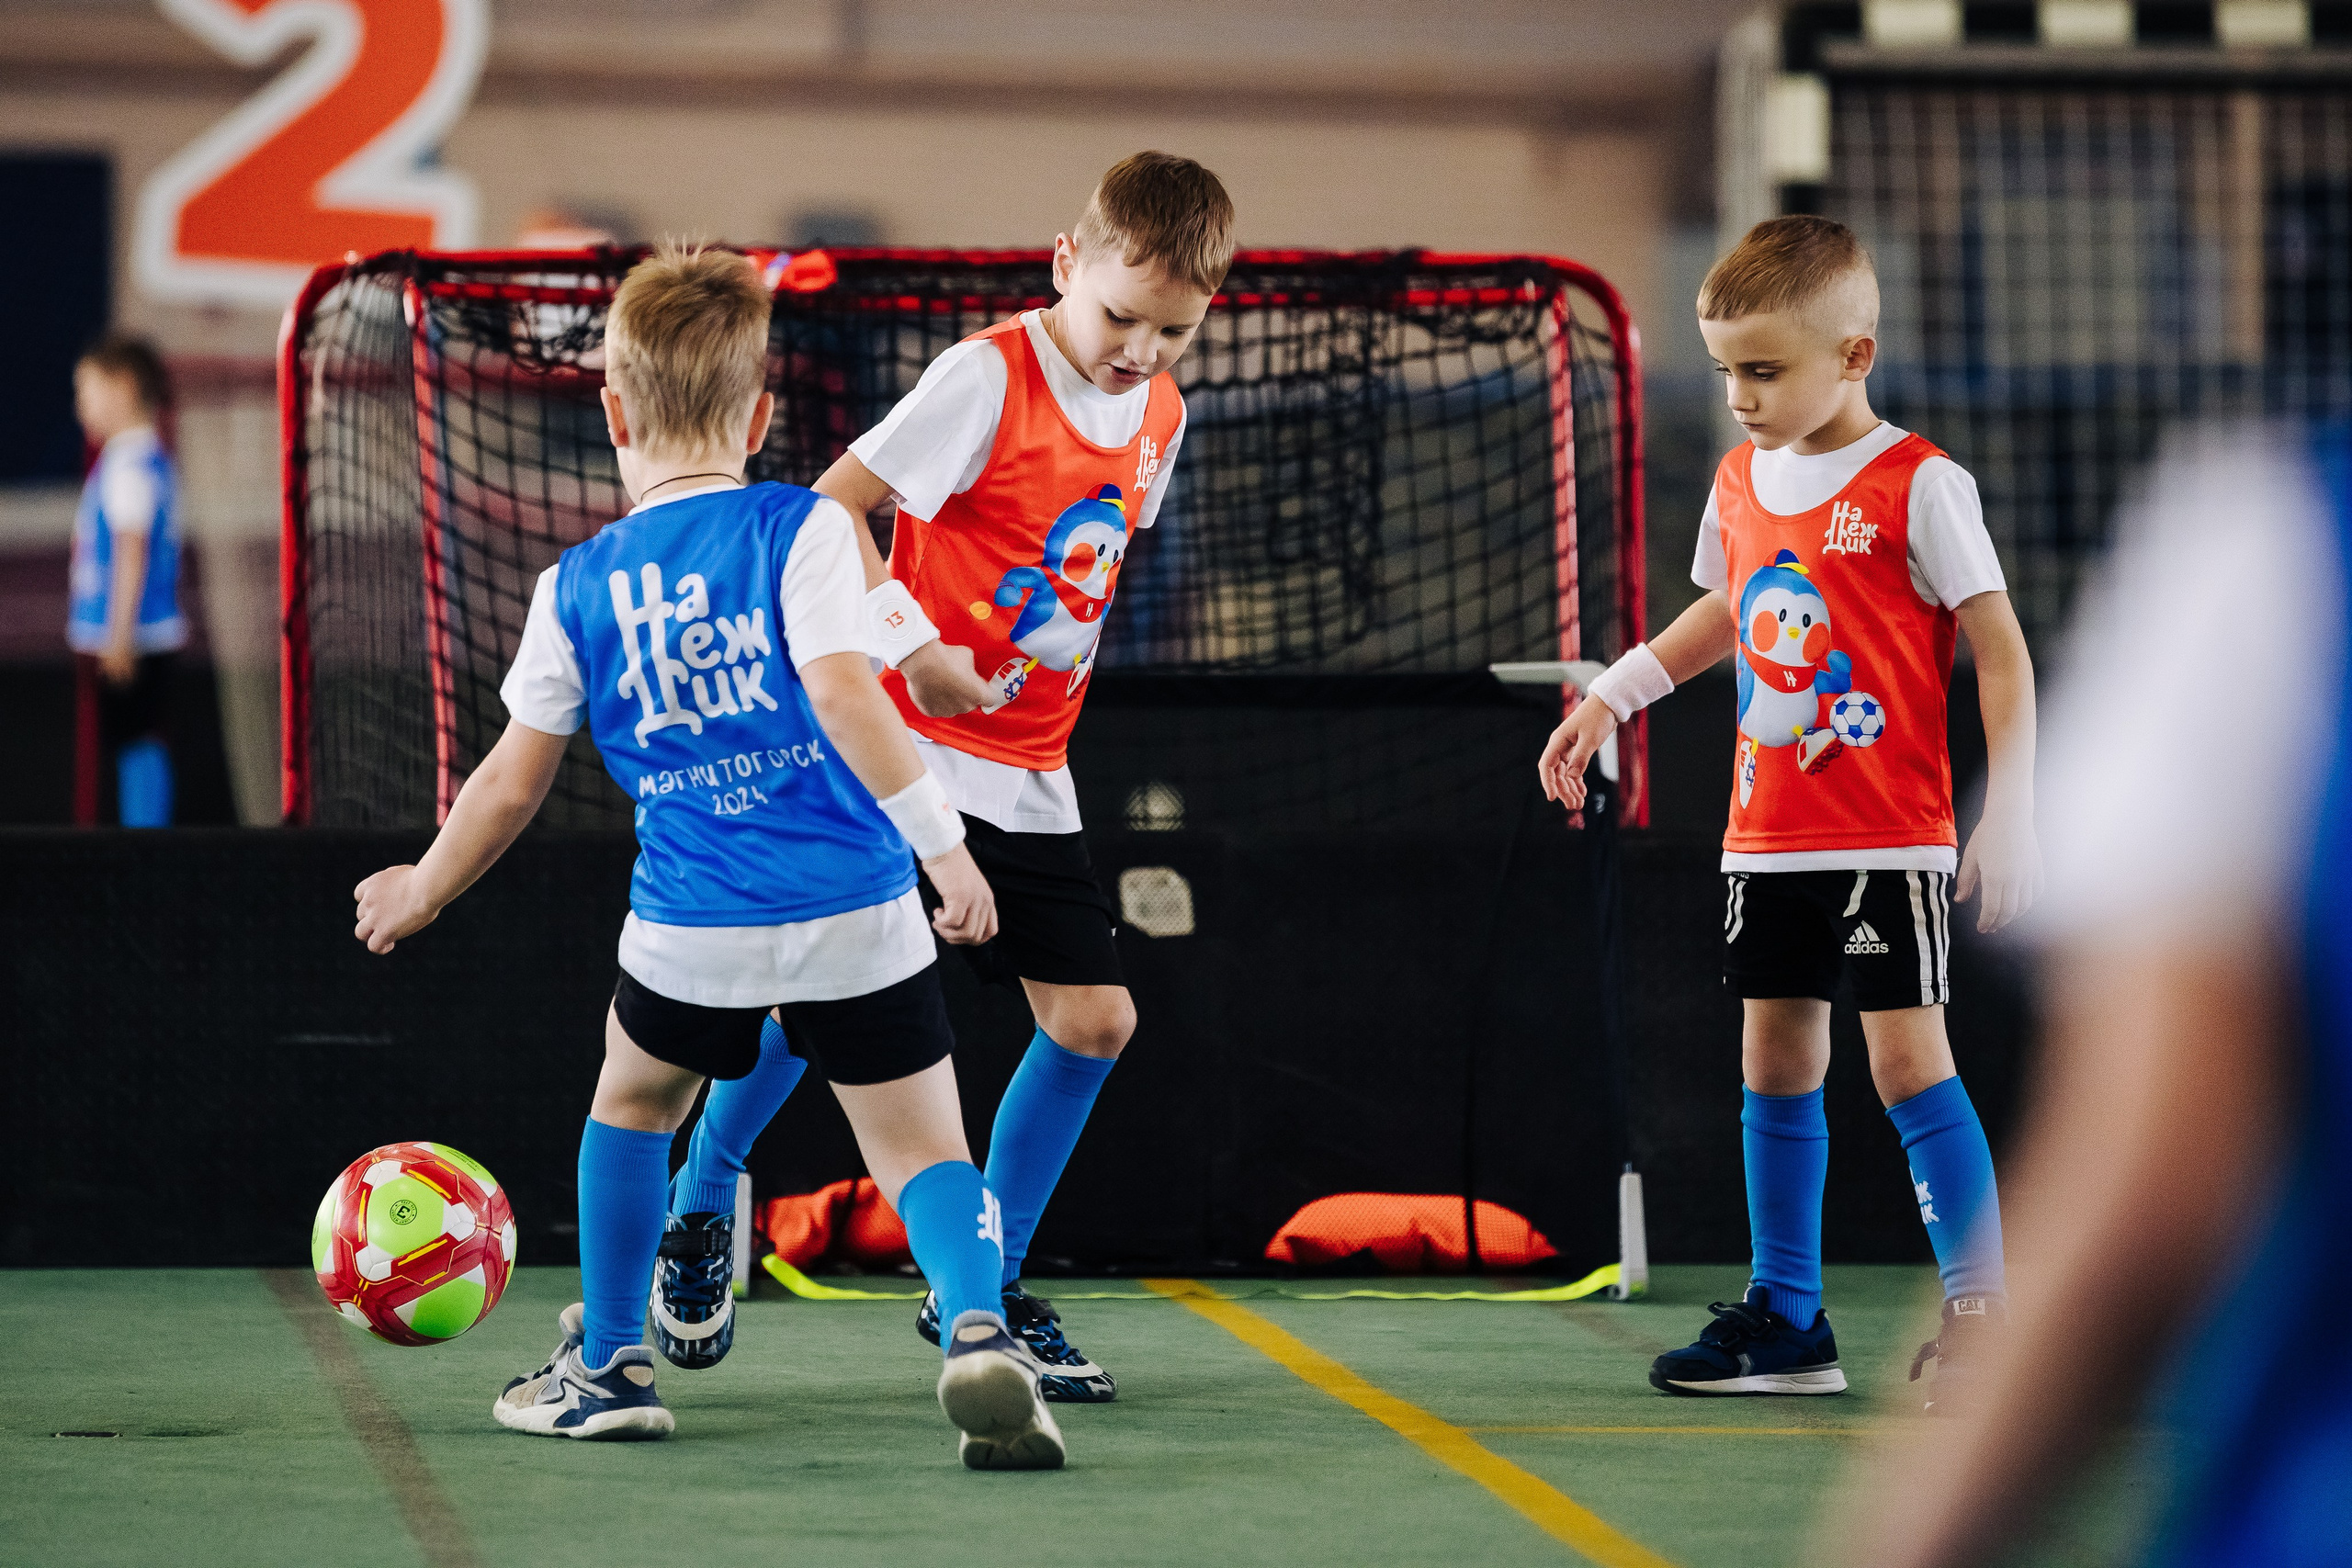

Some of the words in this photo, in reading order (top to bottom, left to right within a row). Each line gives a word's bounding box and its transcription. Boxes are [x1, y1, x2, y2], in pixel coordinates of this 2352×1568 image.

[164, 0, 456, 272] 2
[884, 610, 905, 629] 13
[711, 785, 769, 816] 2024
[1844, 941, 1889, 954] adidas
